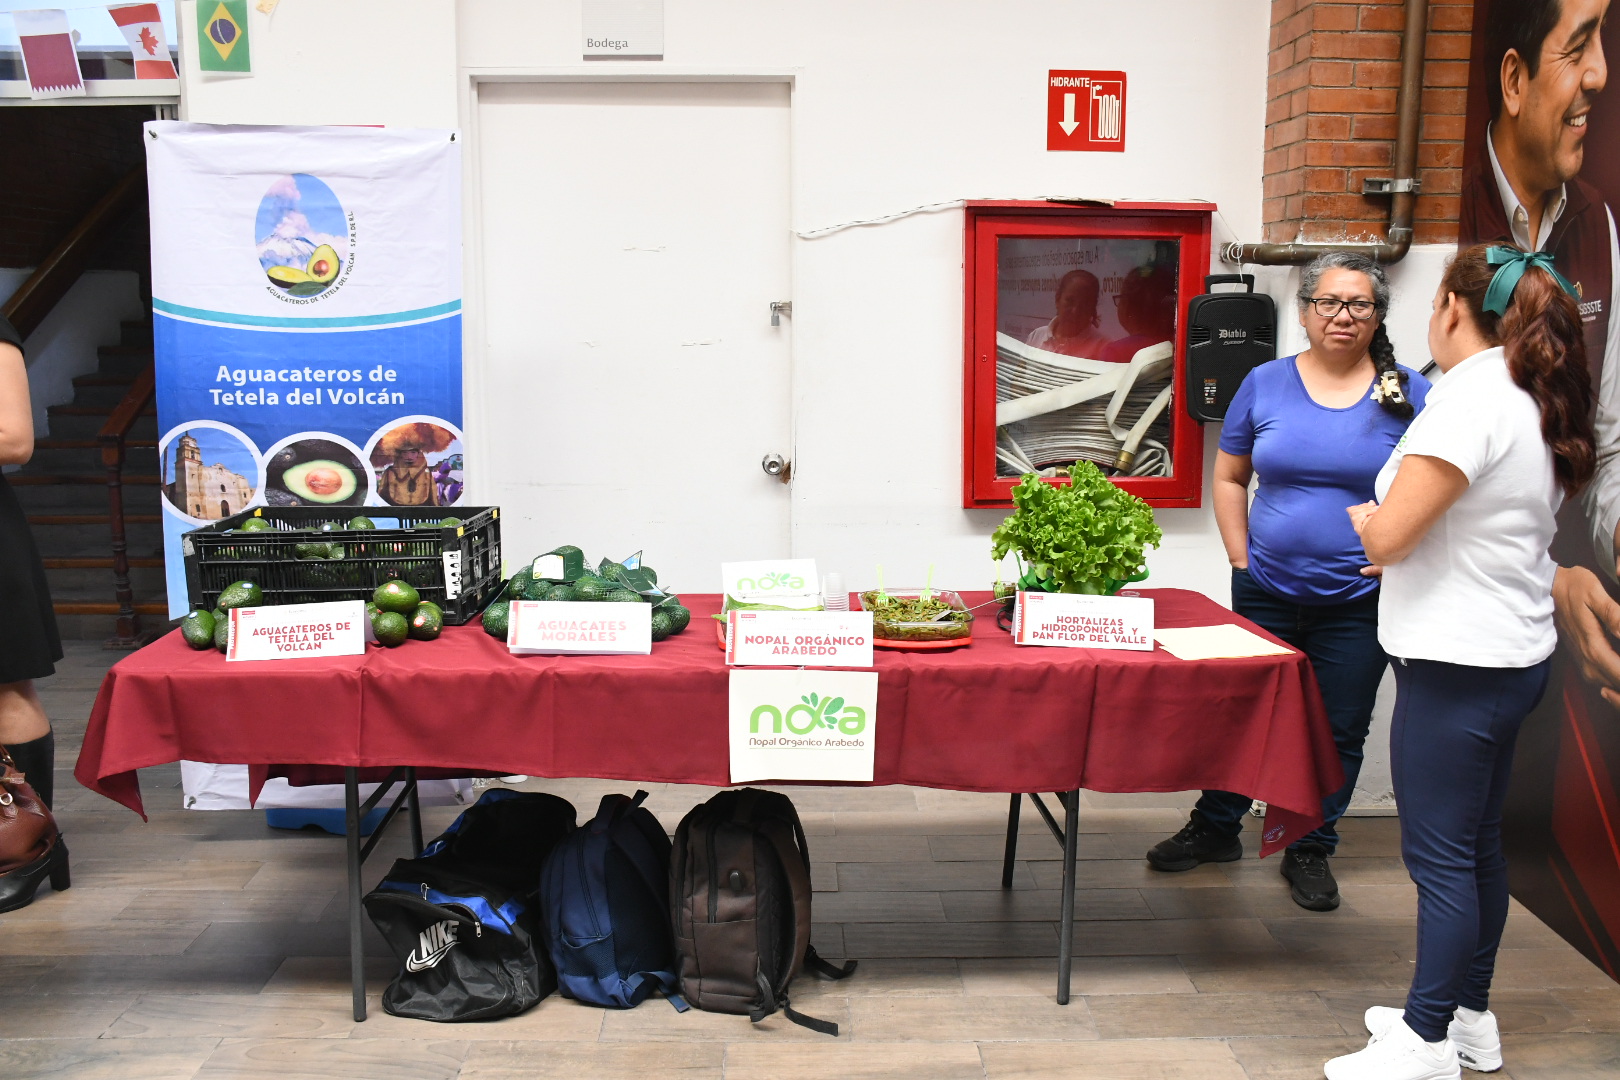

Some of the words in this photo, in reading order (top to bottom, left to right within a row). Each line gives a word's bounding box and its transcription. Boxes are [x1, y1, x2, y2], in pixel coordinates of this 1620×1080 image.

[587, 38, 628, 50] Bodega
[1050, 76, 1090, 88] HIDRANTE
[266, 285, 310, 305] AGUACATEROS
[320, 286, 340, 299] TETELA
[338, 276, 348, 286] DEL
[350, 222, 356, 230] DE
[1219, 329, 1246, 338] Diablo
[216, 366, 362, 386] Aguacateros
[368, 365, 396, 382] de
[209, 388, 278, 405] Tetela
[286, 388, 322, 405] del
[327, 388, 404, 405] Volcán
[538, 620, 627, 630] AGUACATES
[1056, 616, 1124, 626] HORTALIZAS
[252, 624, 332, 636] AGUACATEROS
[336, 622, 350, 630] DE
[268, 634, 309, 644] TETELA
[314, 632, 334, 641] DEL
[542, 632, 616, 642] MORALES
[745, 635, 790, 644] NOPAL
[794, 634, 864, 646] ORGÁNICO
[1032, 632, 1054, 640] PAN
[1058, 633, 1085, 641] FLOR
[1090, 634, 1110, 642] DEL
[1114, 636, 1146, 644] VALLE
[276, 642, 322, 652] VOLCAN
[772, 646, 837, 656] ARABEDO
[749, 738, 776, 747] Nopal
[420, 920, 460, 959] NIKE
